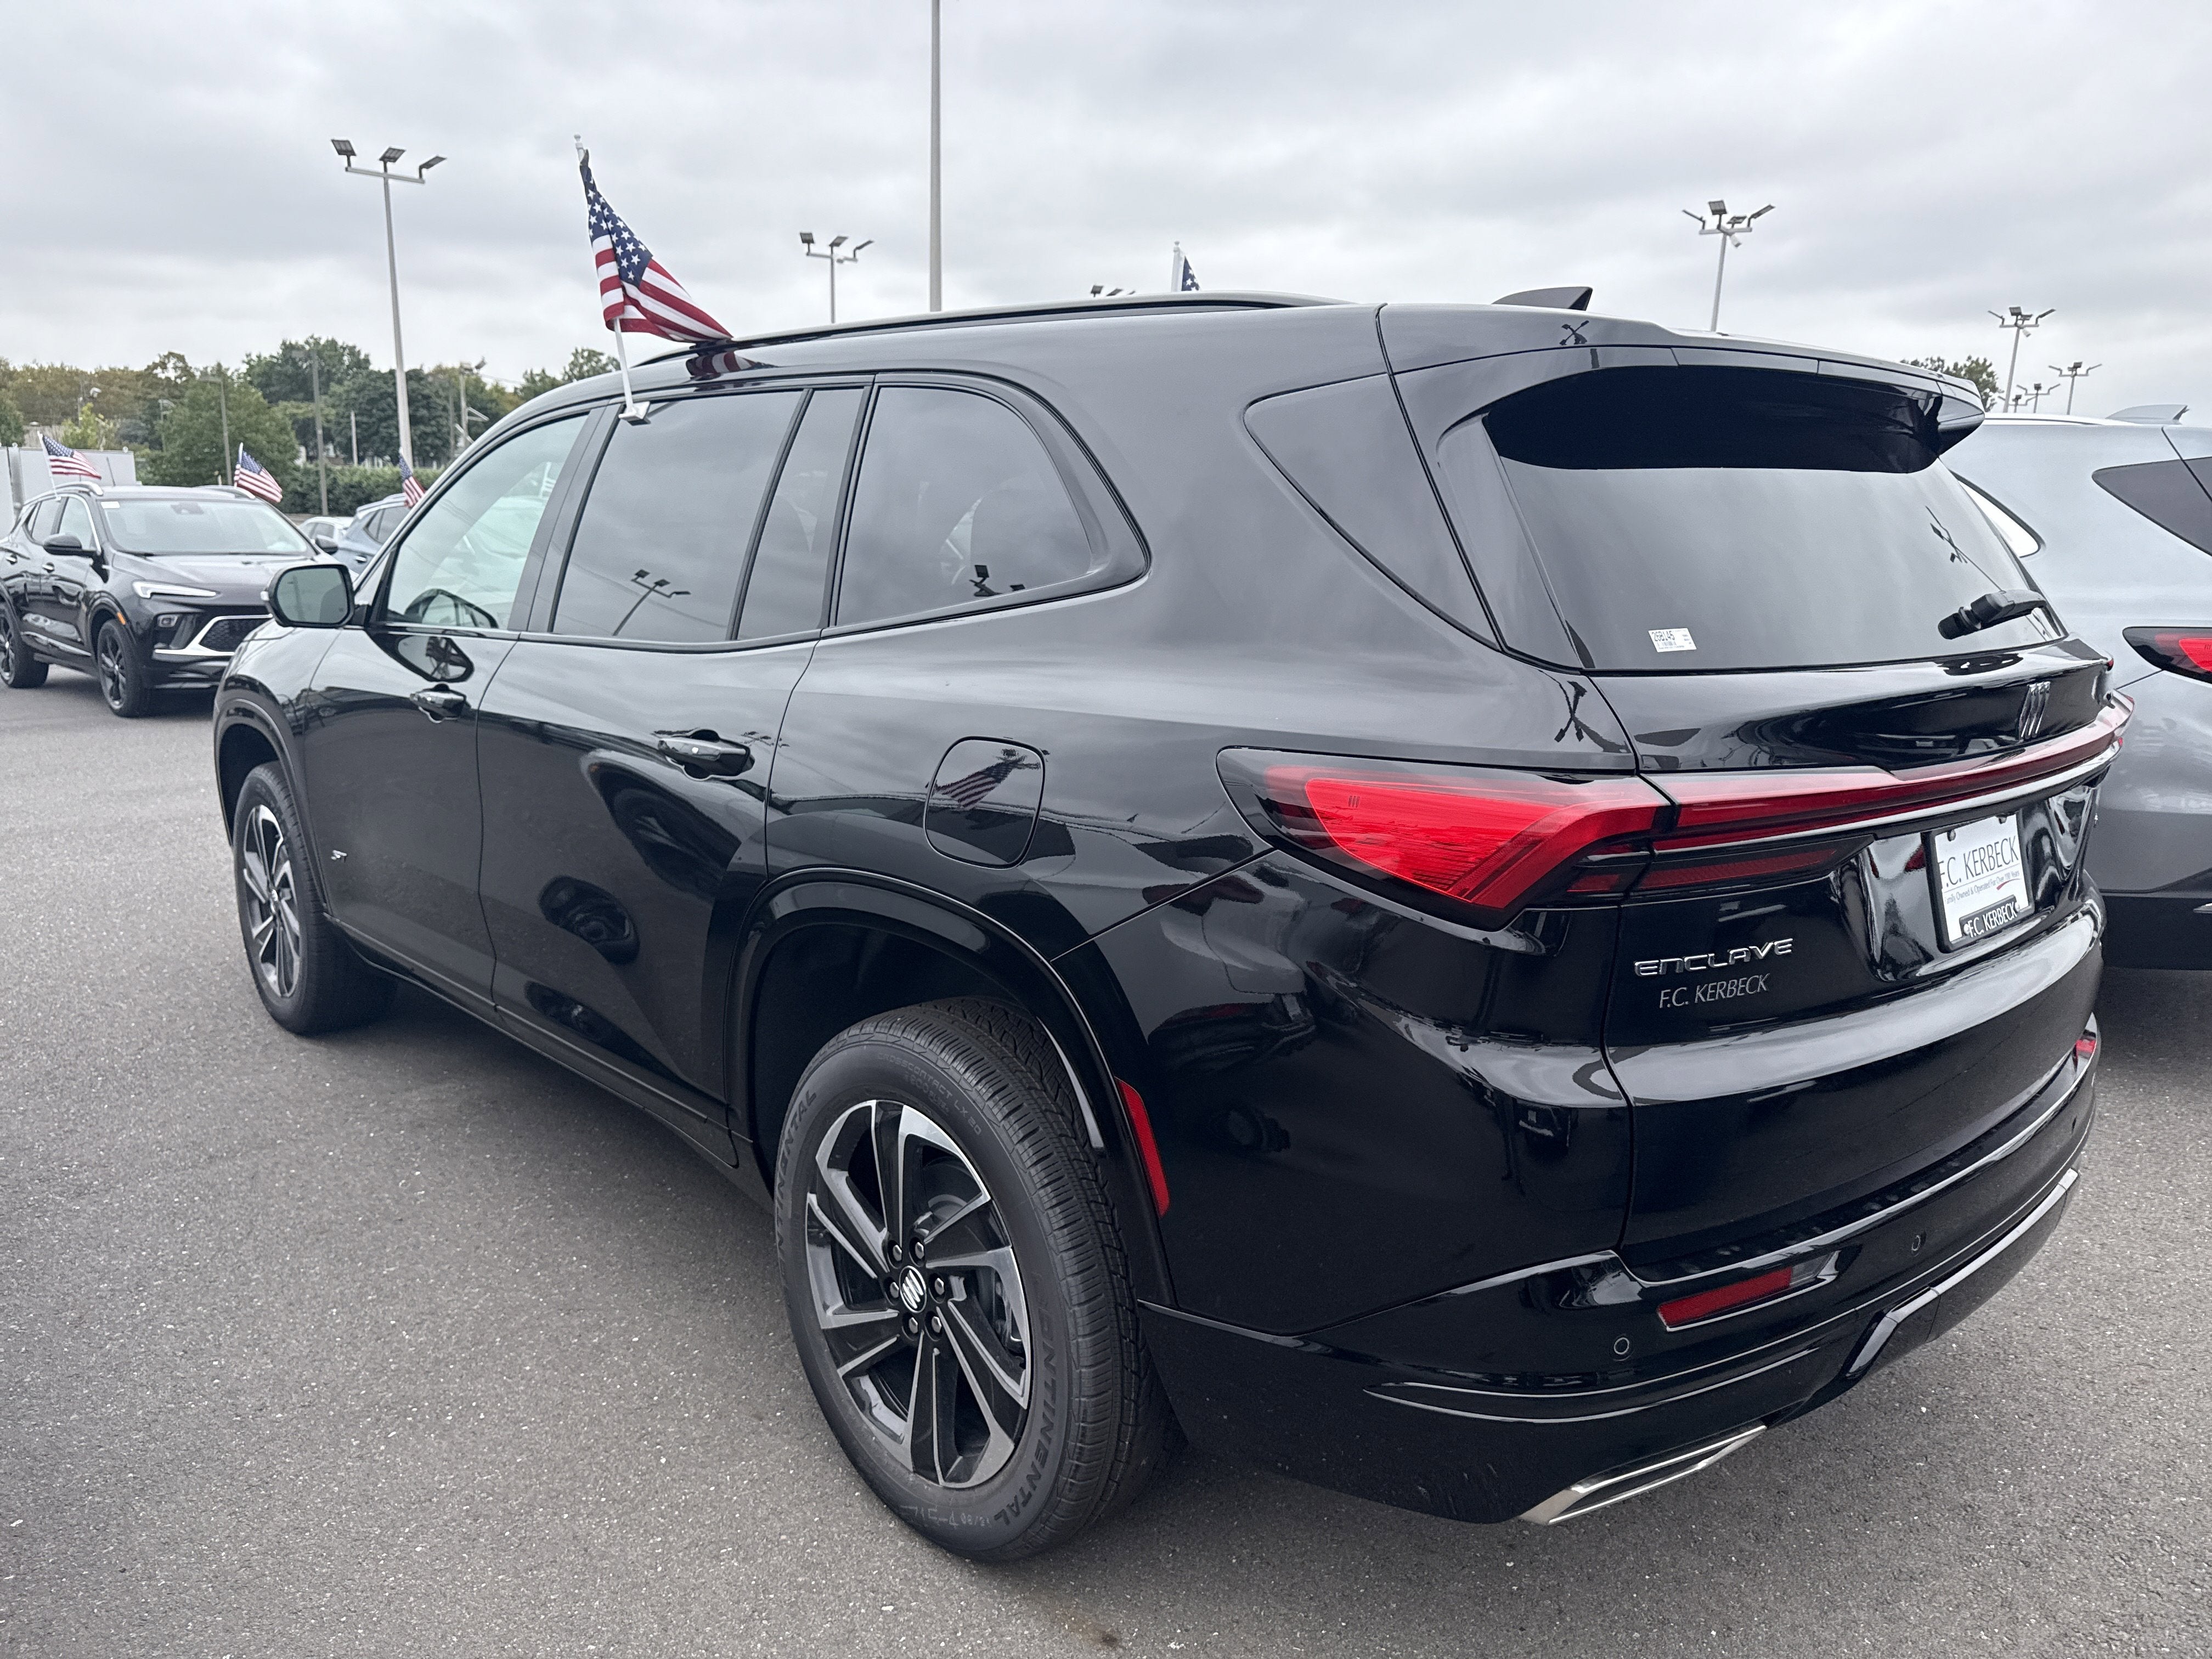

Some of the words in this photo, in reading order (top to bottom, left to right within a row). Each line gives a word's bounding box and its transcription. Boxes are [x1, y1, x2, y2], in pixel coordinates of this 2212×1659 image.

[1963, 836, 2019, 879] KERBECK
[1967, 917, 1984, 938] F.C.
[1982, 901, 2018, 931] KERBECK
[1635, 938, 1793, 977] ENCLAVE
[1659, 987, 1689, 1008] F.C.
[1694, 973, 1770, 1003] KERBECK
